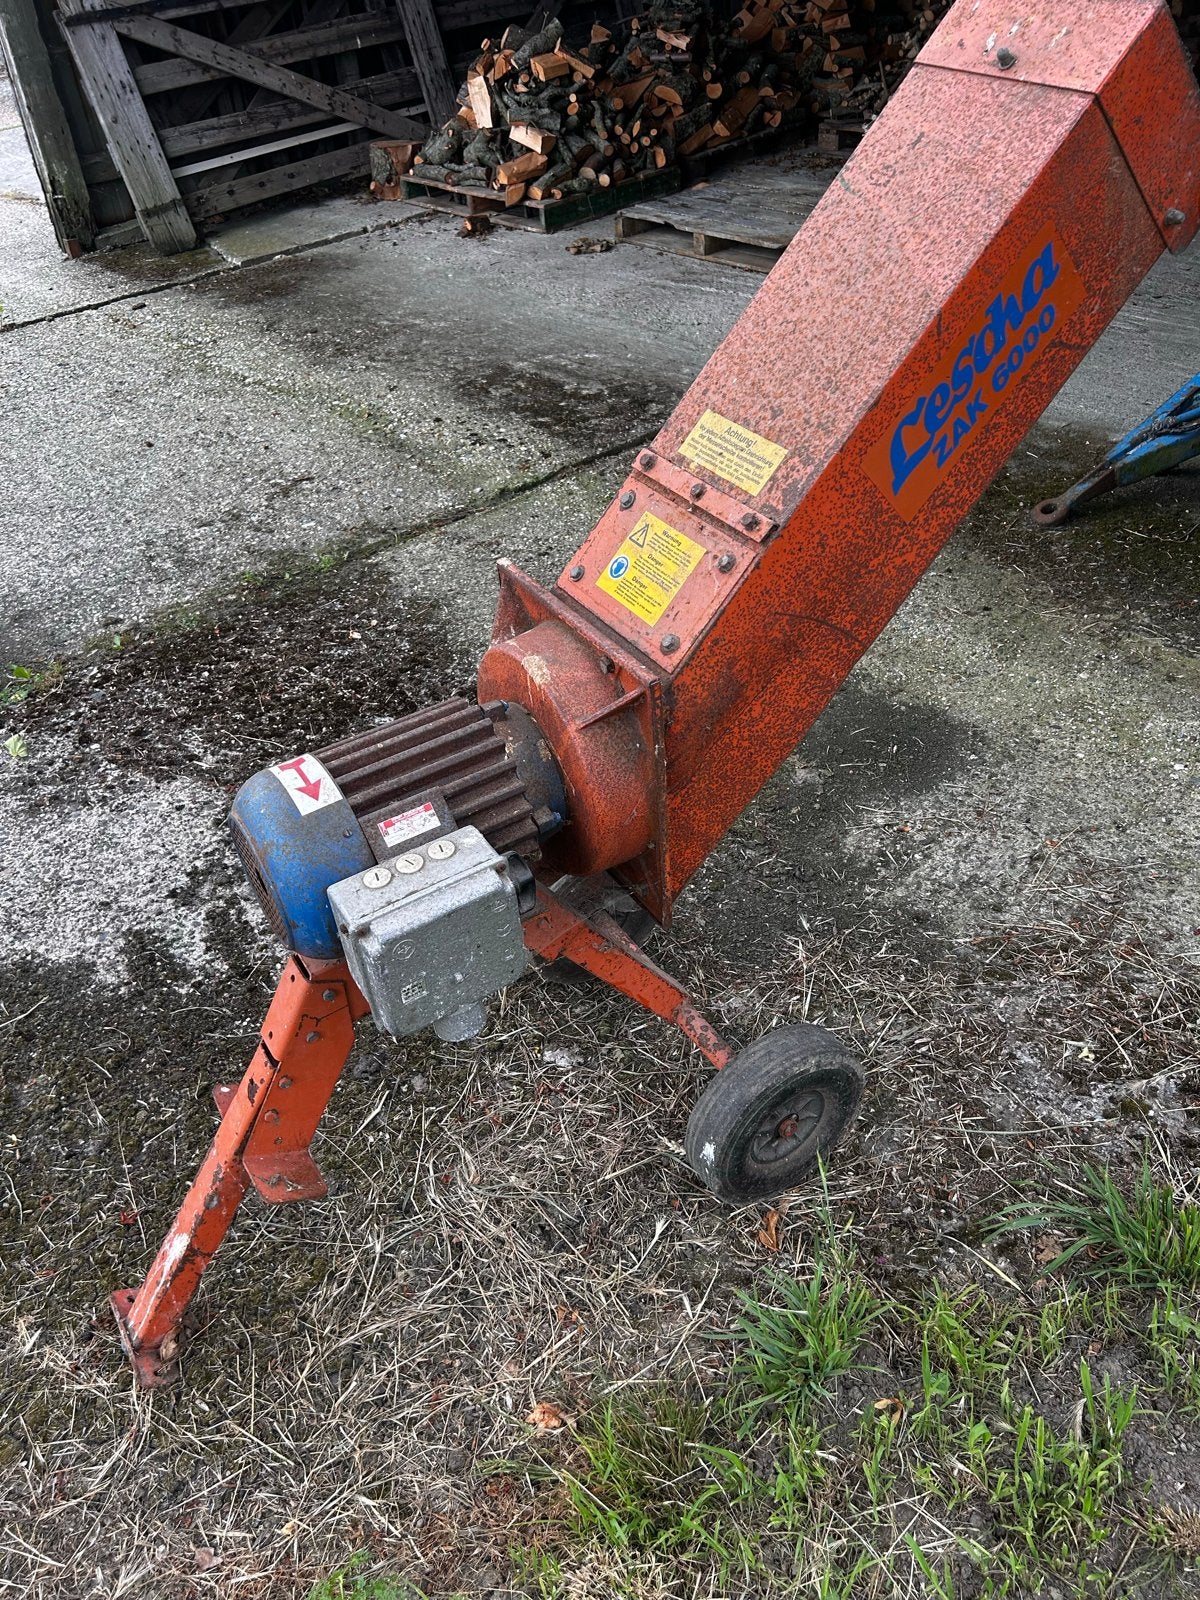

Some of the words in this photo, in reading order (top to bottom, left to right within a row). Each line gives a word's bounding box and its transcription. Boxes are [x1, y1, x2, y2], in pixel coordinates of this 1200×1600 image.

[890, 241, 1060, 496] Lescha
[933, 387, 989, 469] ZAK
[991, 304, 1056, 393] 6000
[724, 426, 758, 448] Achtung!
[662, 530, 681, 546] Warnung
[647, 553, 664, 567] Danger
[632, 576, 648, 590] Danger
